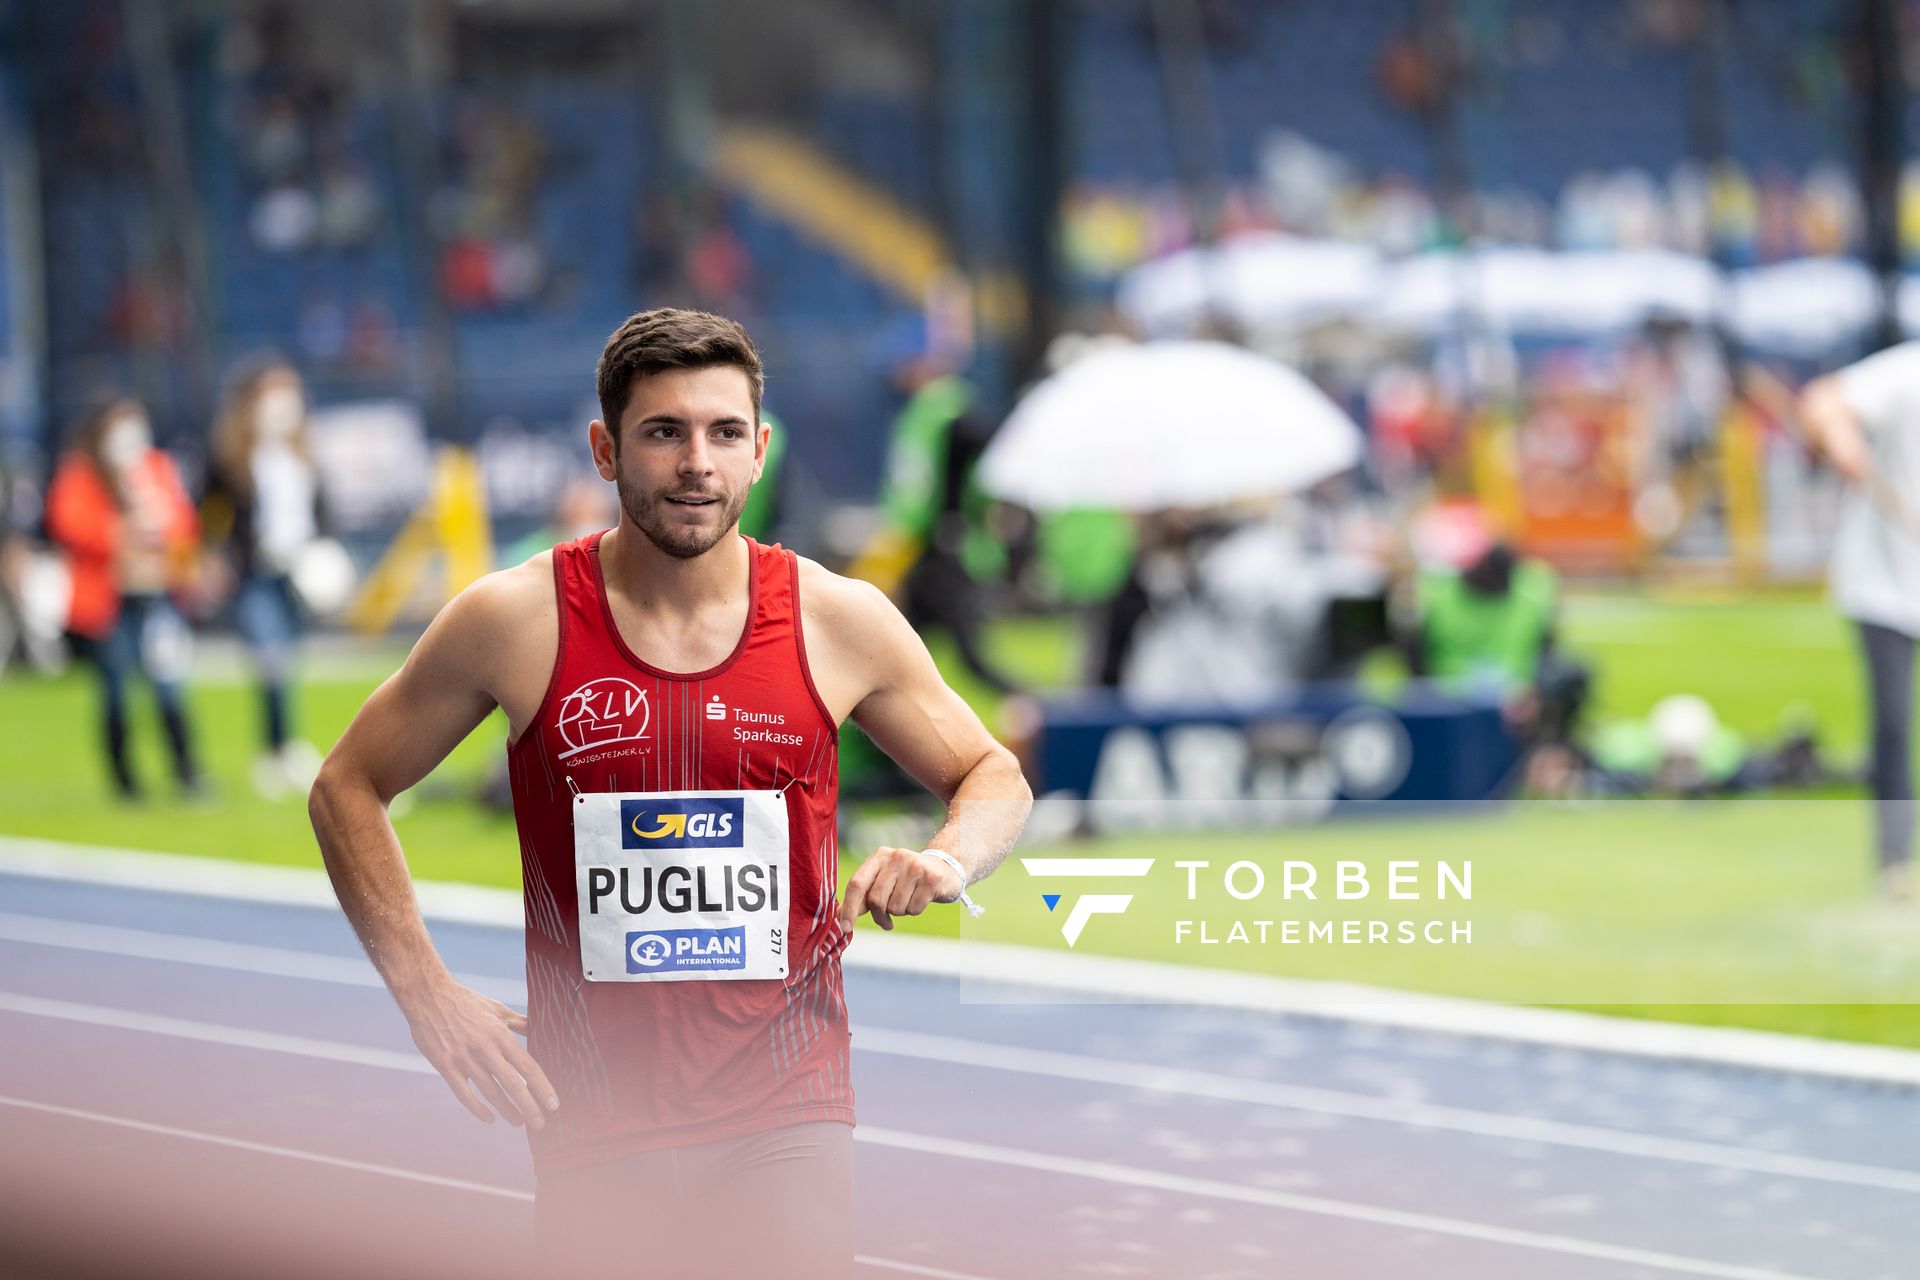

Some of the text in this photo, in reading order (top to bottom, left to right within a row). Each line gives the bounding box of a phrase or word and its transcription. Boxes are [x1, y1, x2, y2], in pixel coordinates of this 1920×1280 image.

[733, 707, 785, 725] Taunus
[733, 726, 804, 746] Sparkasse
[687, 813, 733, 838] GLS
[588, 864, 780, 915] PUGLISI
[675, 935, 741, 956] PLAN
[770, 928, 782, 956] 277
[676, 958, 741, 966] INTERNATIONAL
